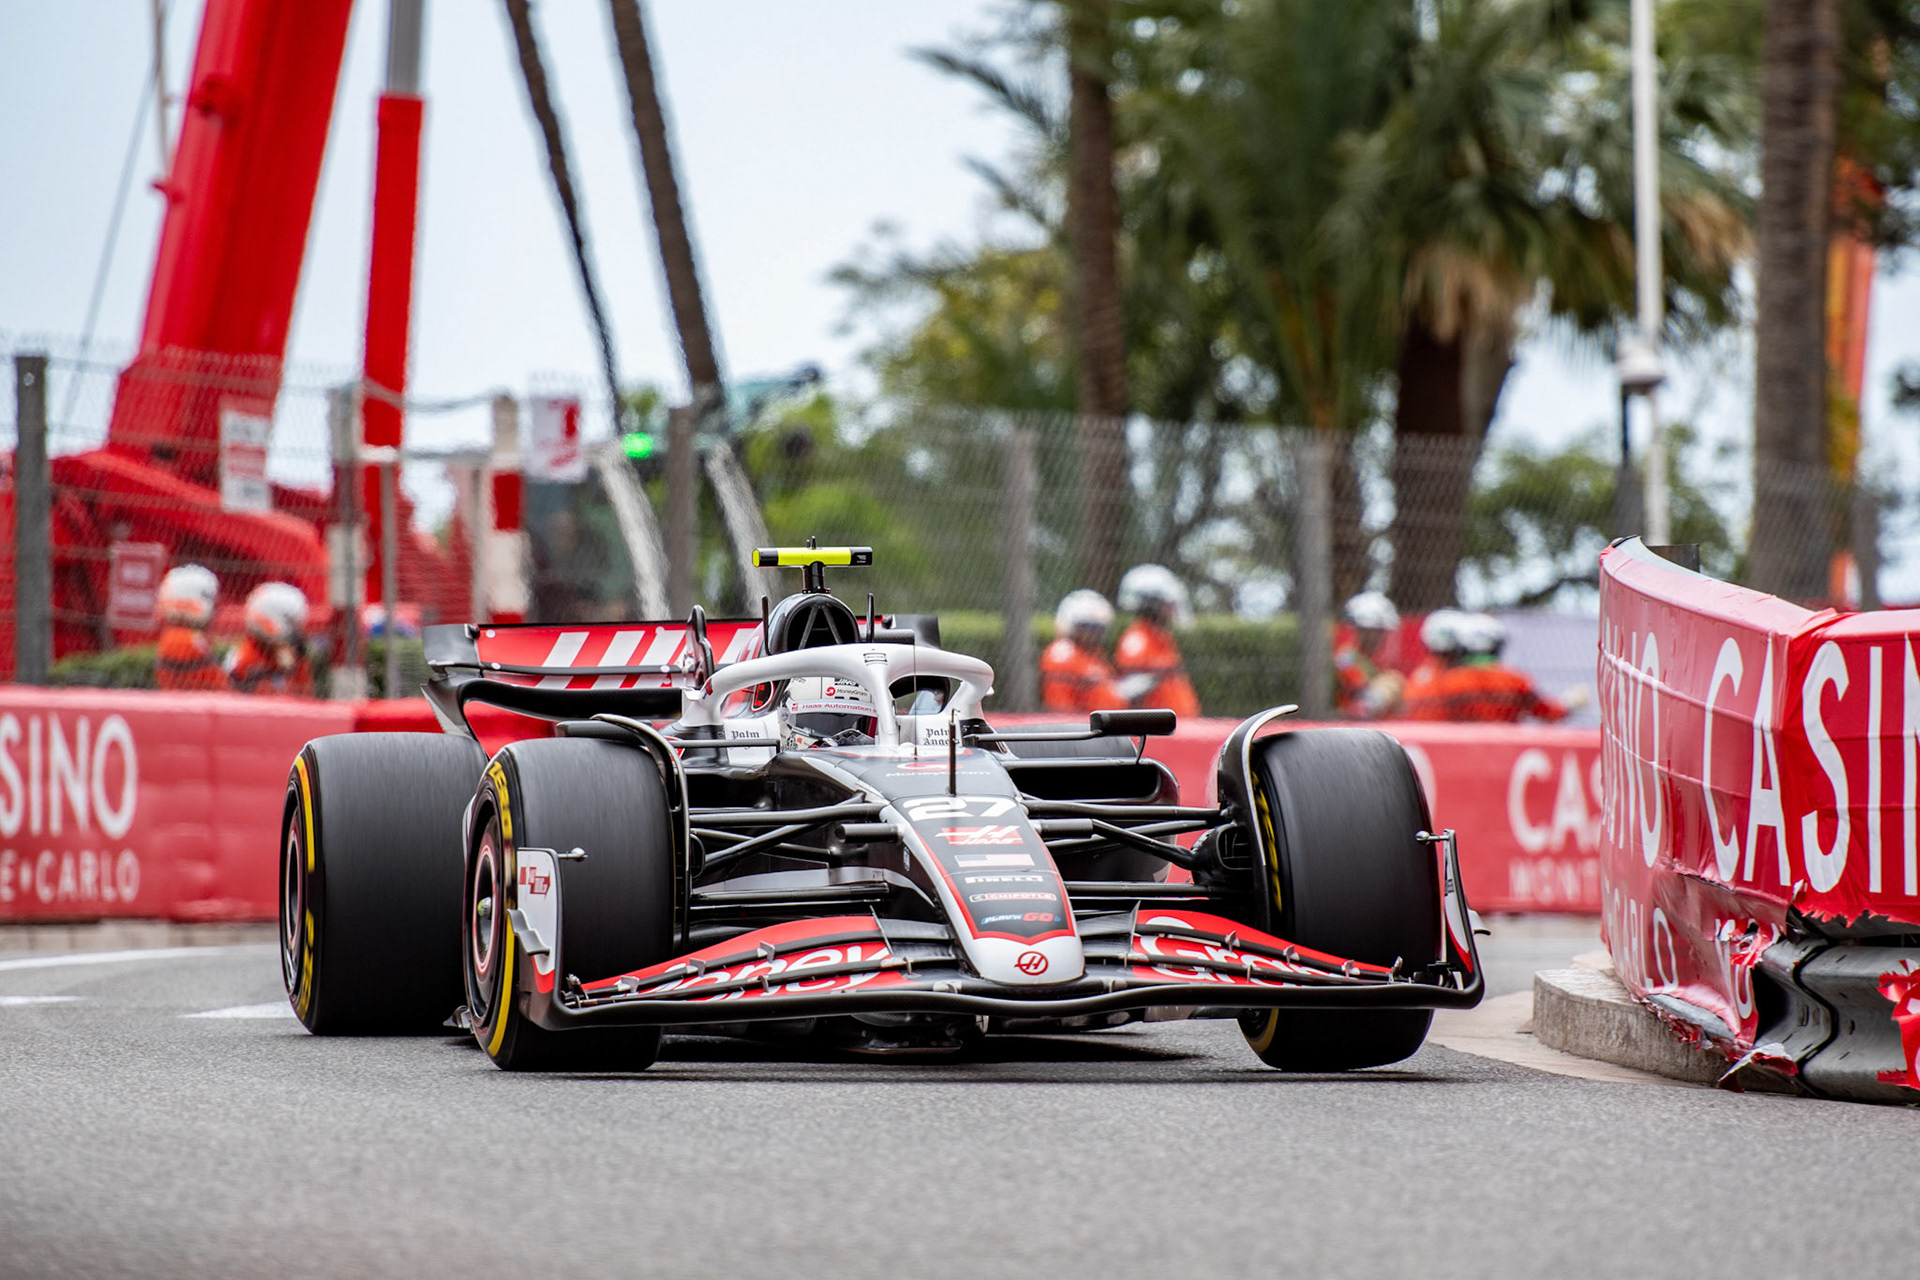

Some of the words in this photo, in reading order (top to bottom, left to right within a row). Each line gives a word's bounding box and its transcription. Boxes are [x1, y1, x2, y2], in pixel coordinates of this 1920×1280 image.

[837, 688, 868, 697] MoneyGram
[824, 703, 872, 712] Automation
[731, 730, 760, 740] Palm
[902, 797, 1018, 822] 27
[1022, 912, 1054, 922] GO
